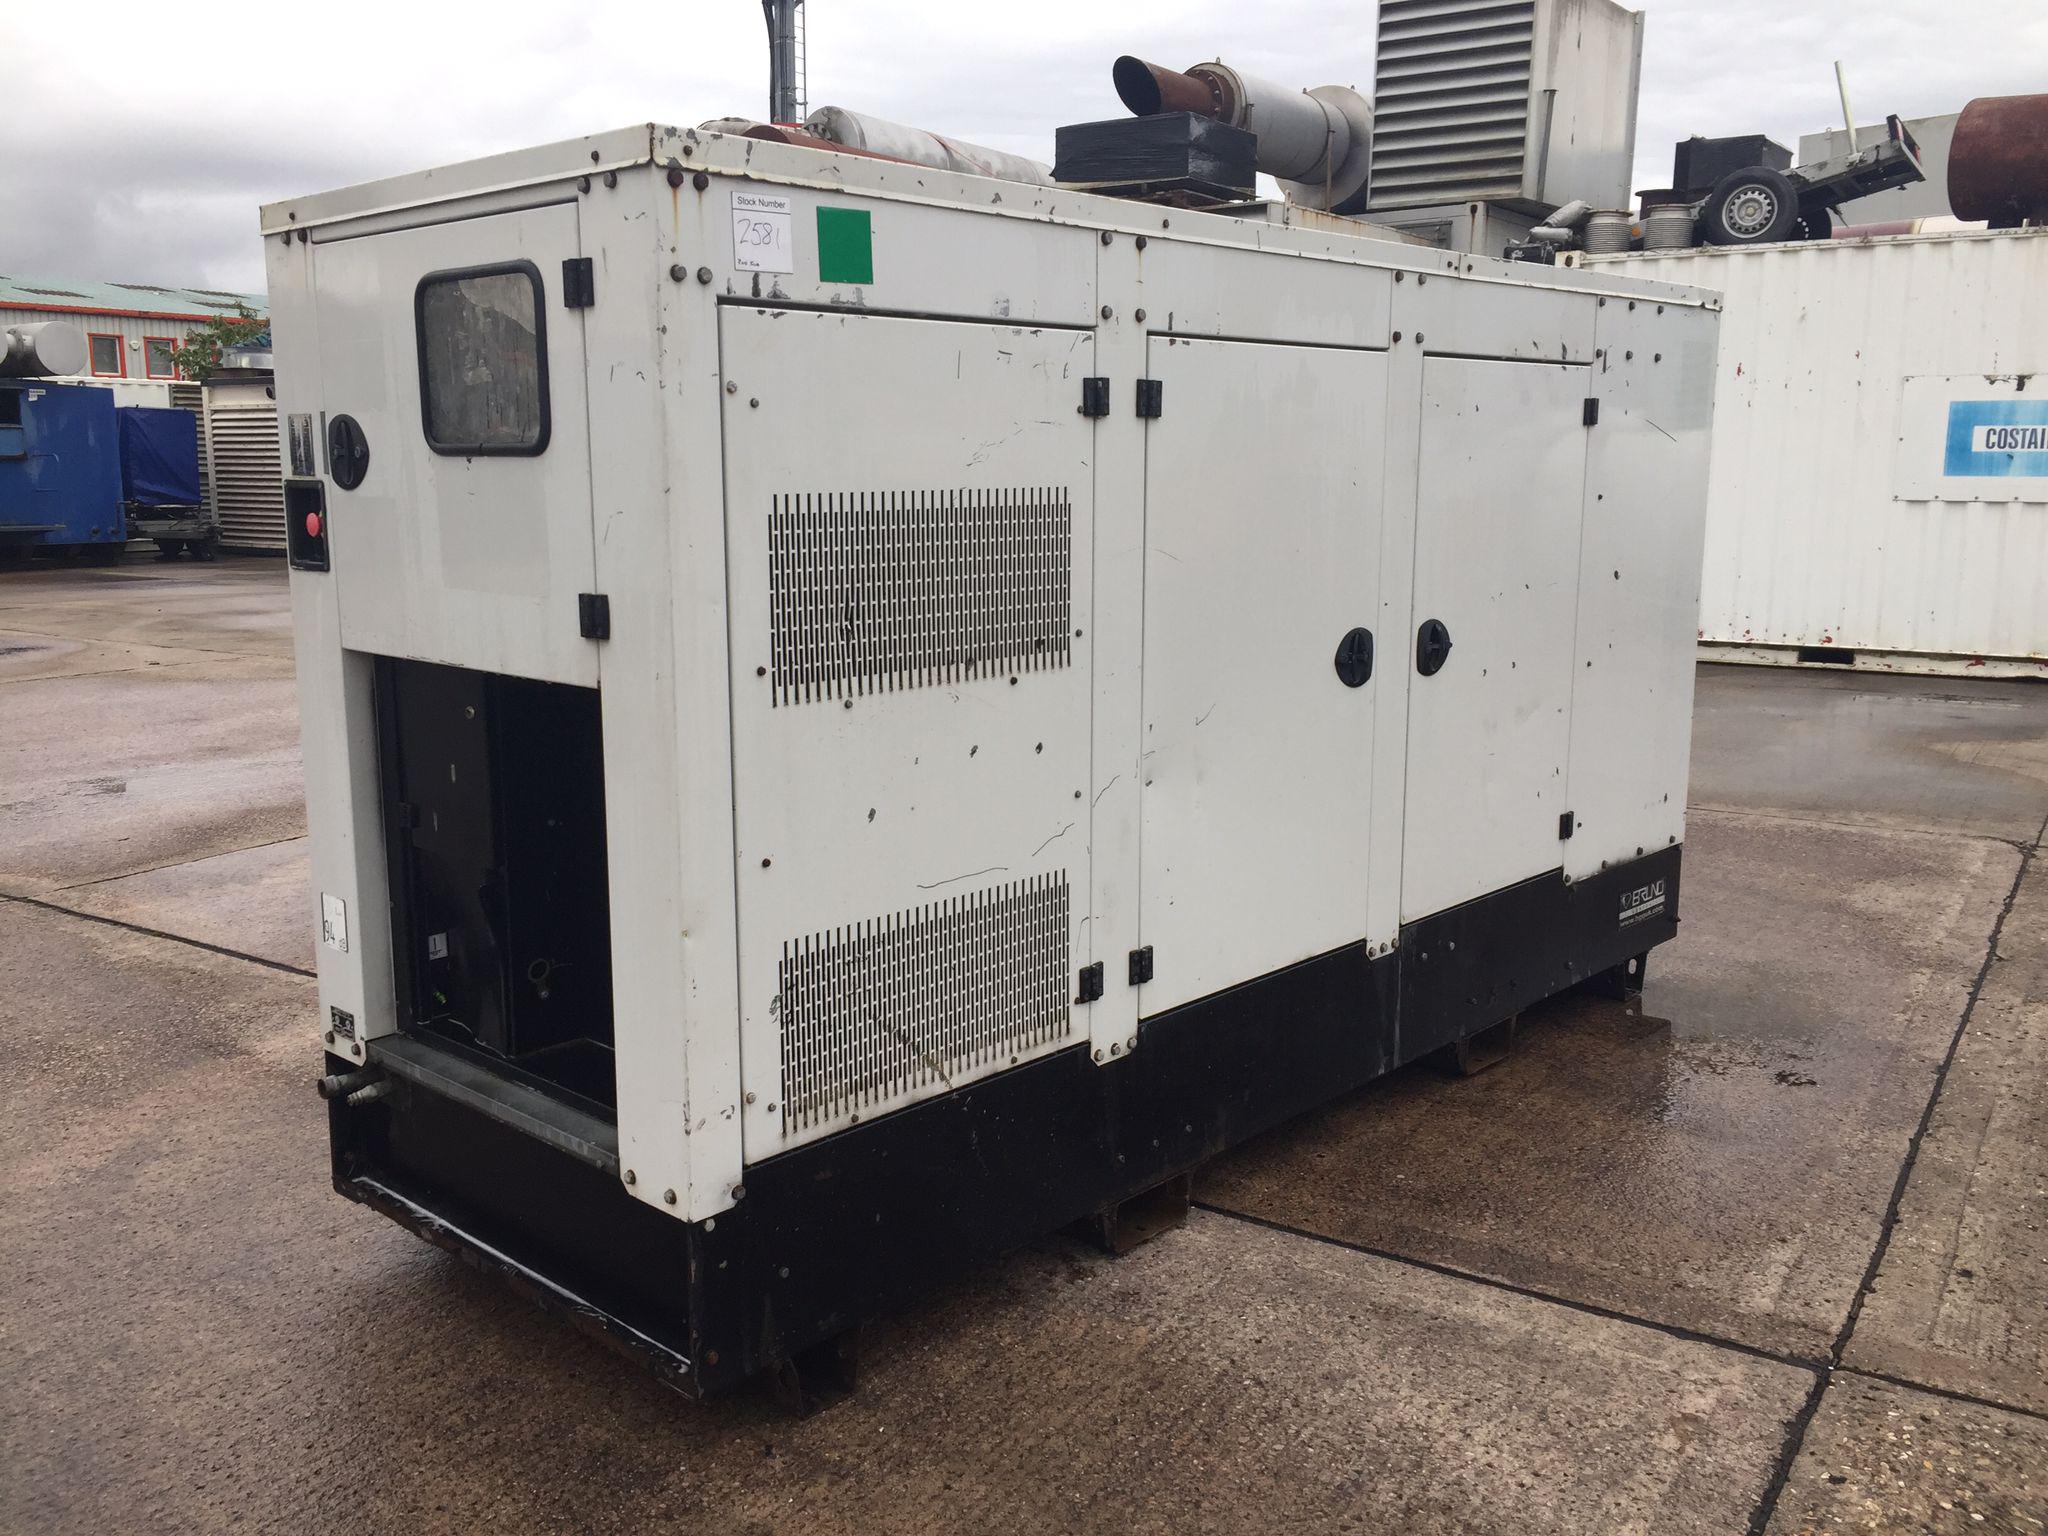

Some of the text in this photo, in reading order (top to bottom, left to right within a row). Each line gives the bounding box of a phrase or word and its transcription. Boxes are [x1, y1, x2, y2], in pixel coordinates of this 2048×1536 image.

[737, 196, 786, 209] Stock Number
[737, 218, 780, 250] 2581
[1985, 427, 2048, 450] COSTAI
